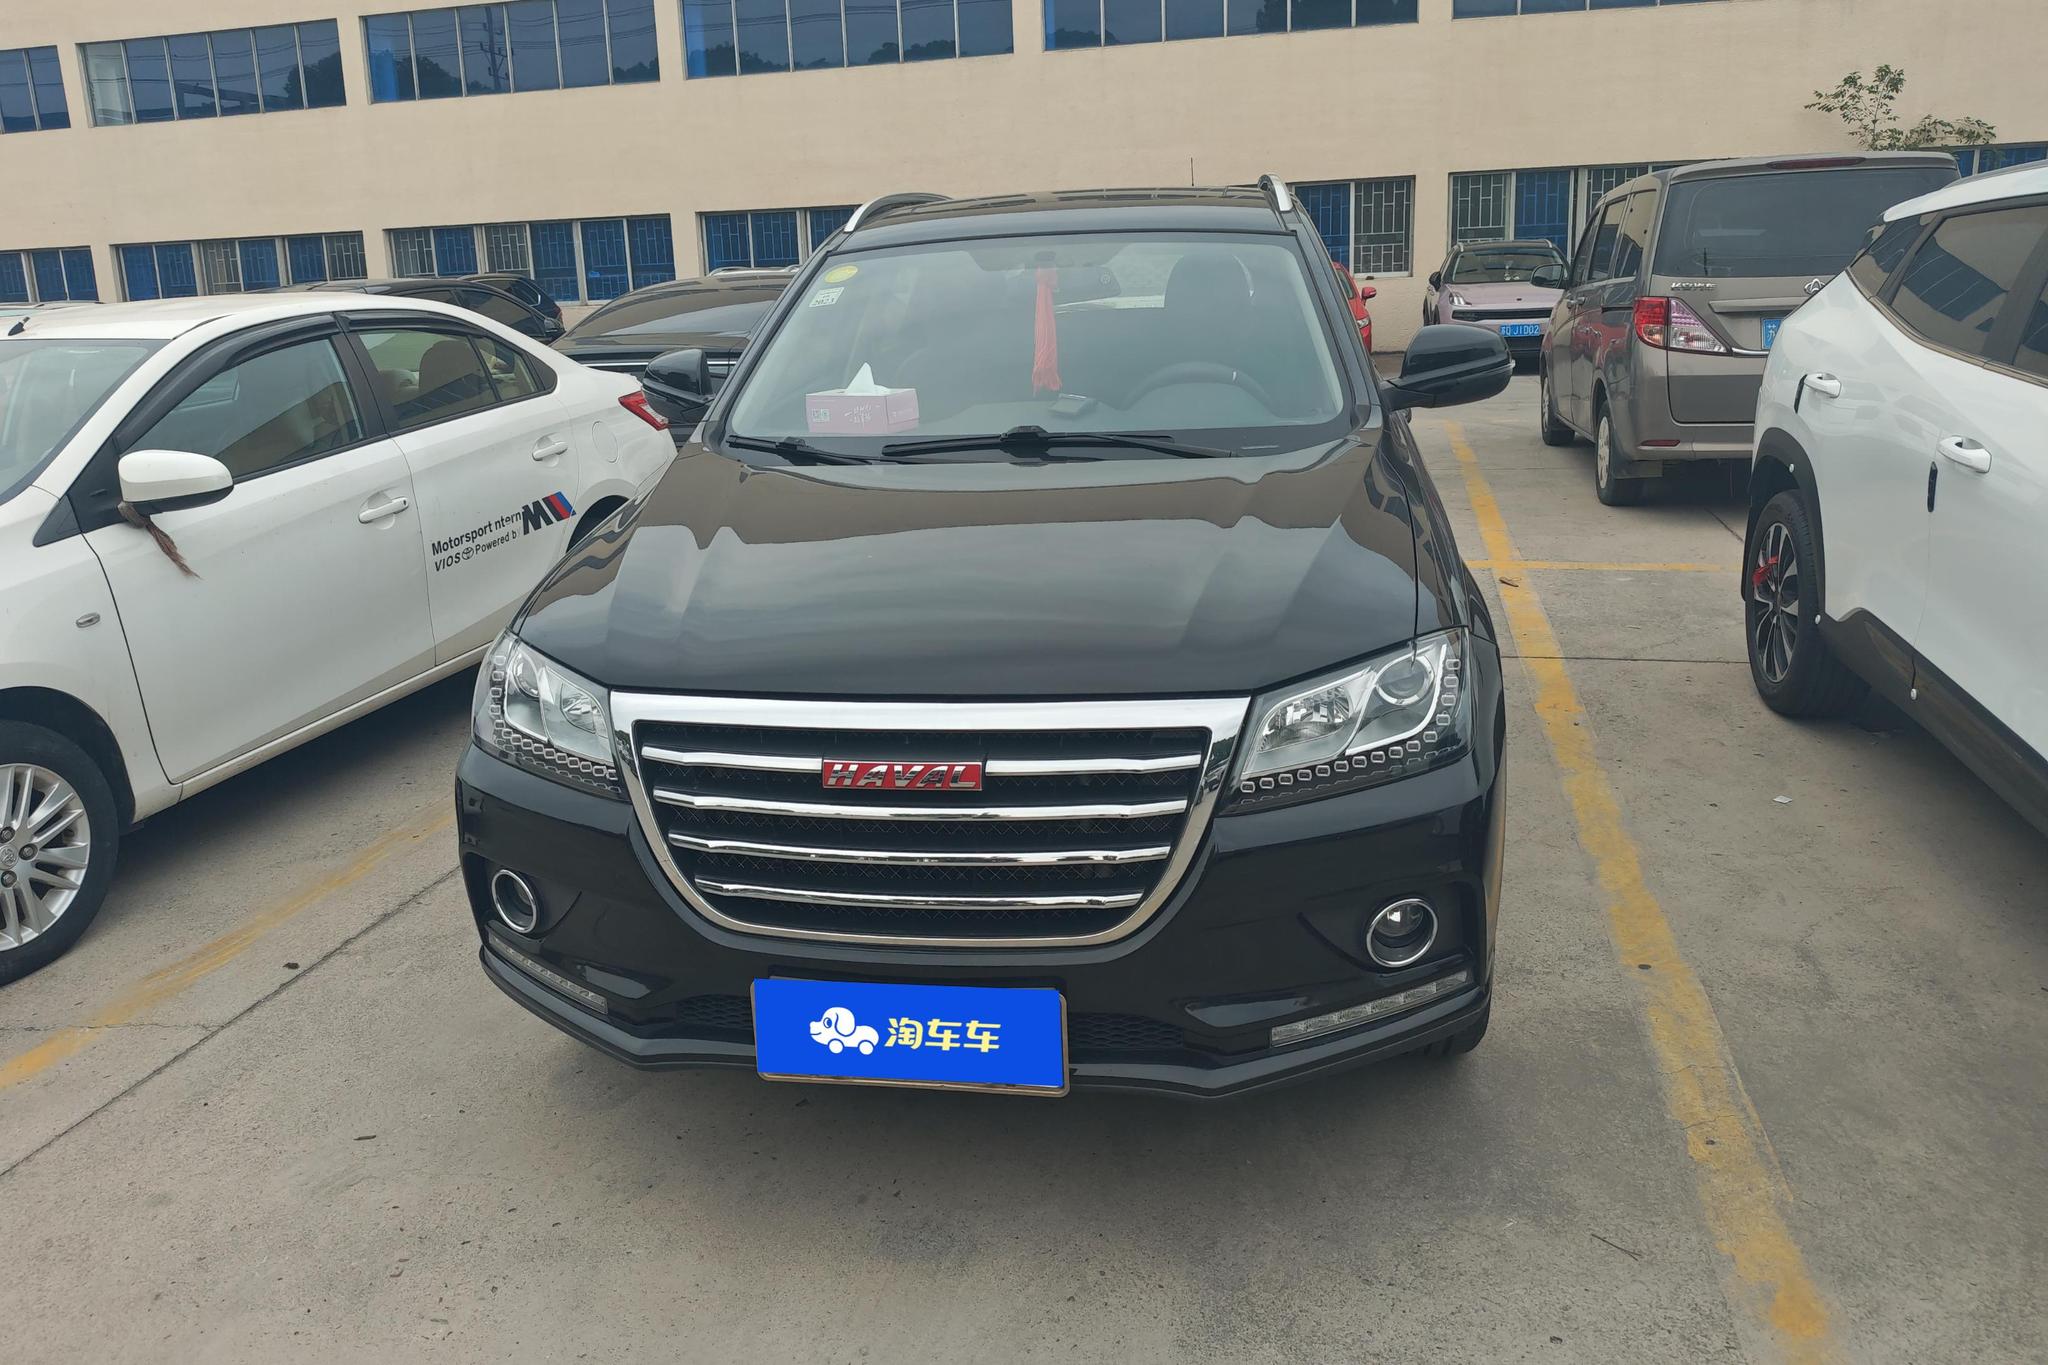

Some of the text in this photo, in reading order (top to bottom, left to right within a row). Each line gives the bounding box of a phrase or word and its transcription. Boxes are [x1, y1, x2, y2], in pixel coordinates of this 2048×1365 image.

[431, 521, 493, 556] Motorsport
[434, 552, 461, 572] VIOS
[475, 535, 510, 555] Powered
[827, 764, 977, 788] HAVAL
